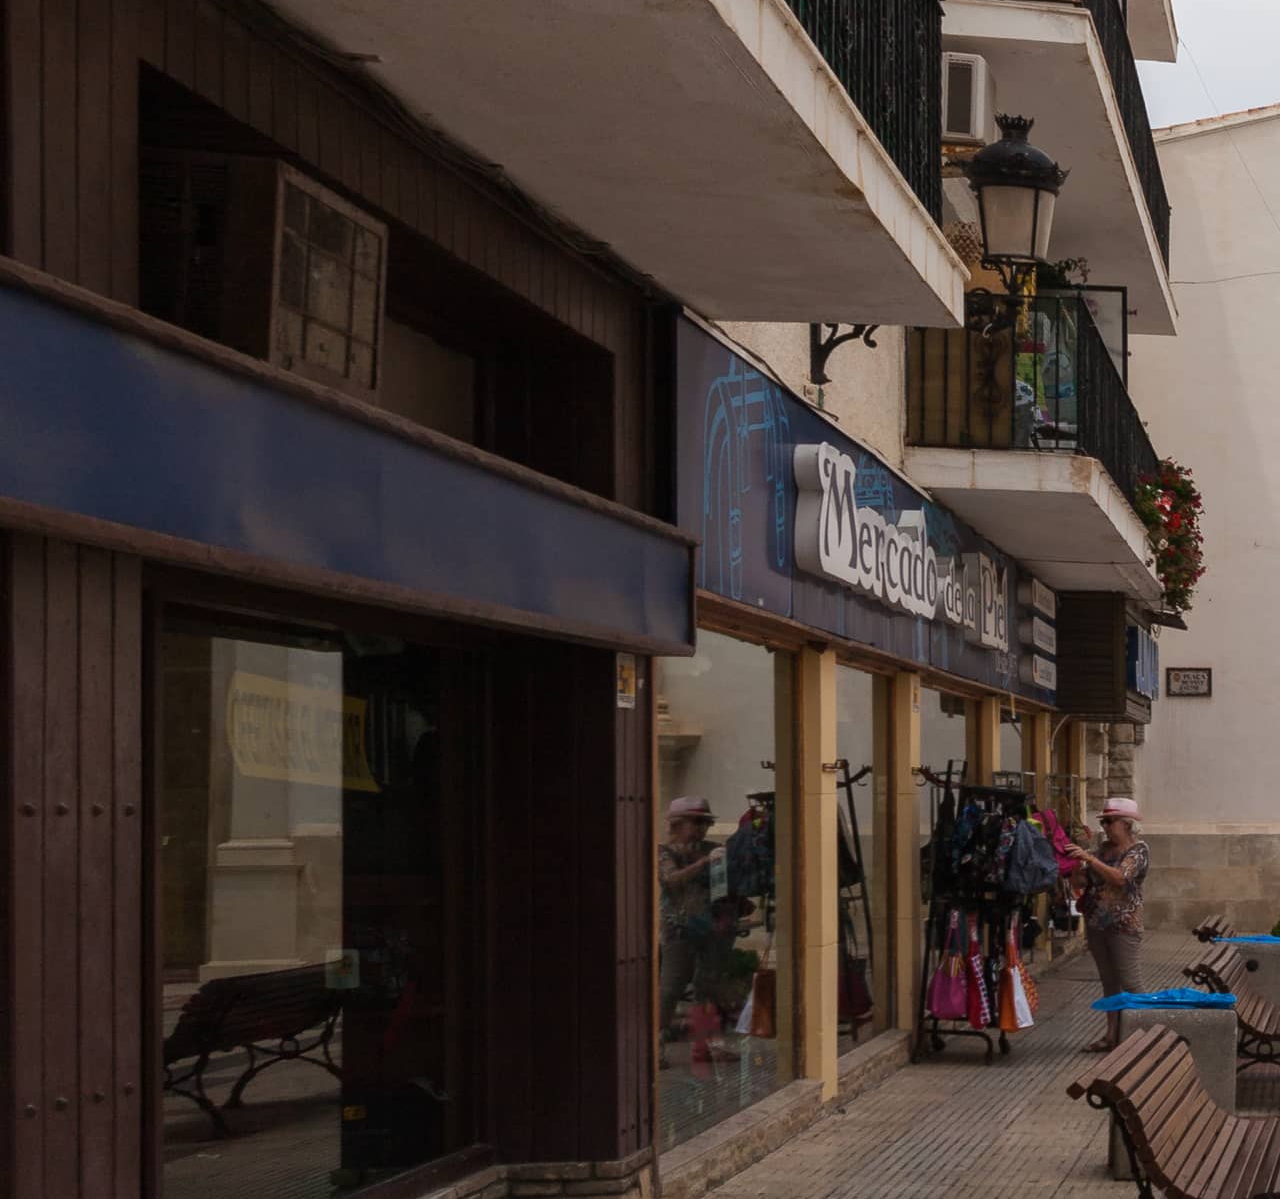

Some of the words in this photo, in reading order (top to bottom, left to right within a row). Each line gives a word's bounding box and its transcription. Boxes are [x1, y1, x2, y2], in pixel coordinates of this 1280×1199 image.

[823, 456, 938, 608] Mercado
[944, 569, 961, 618] de
[981, 563, 1008, 645] Piel
